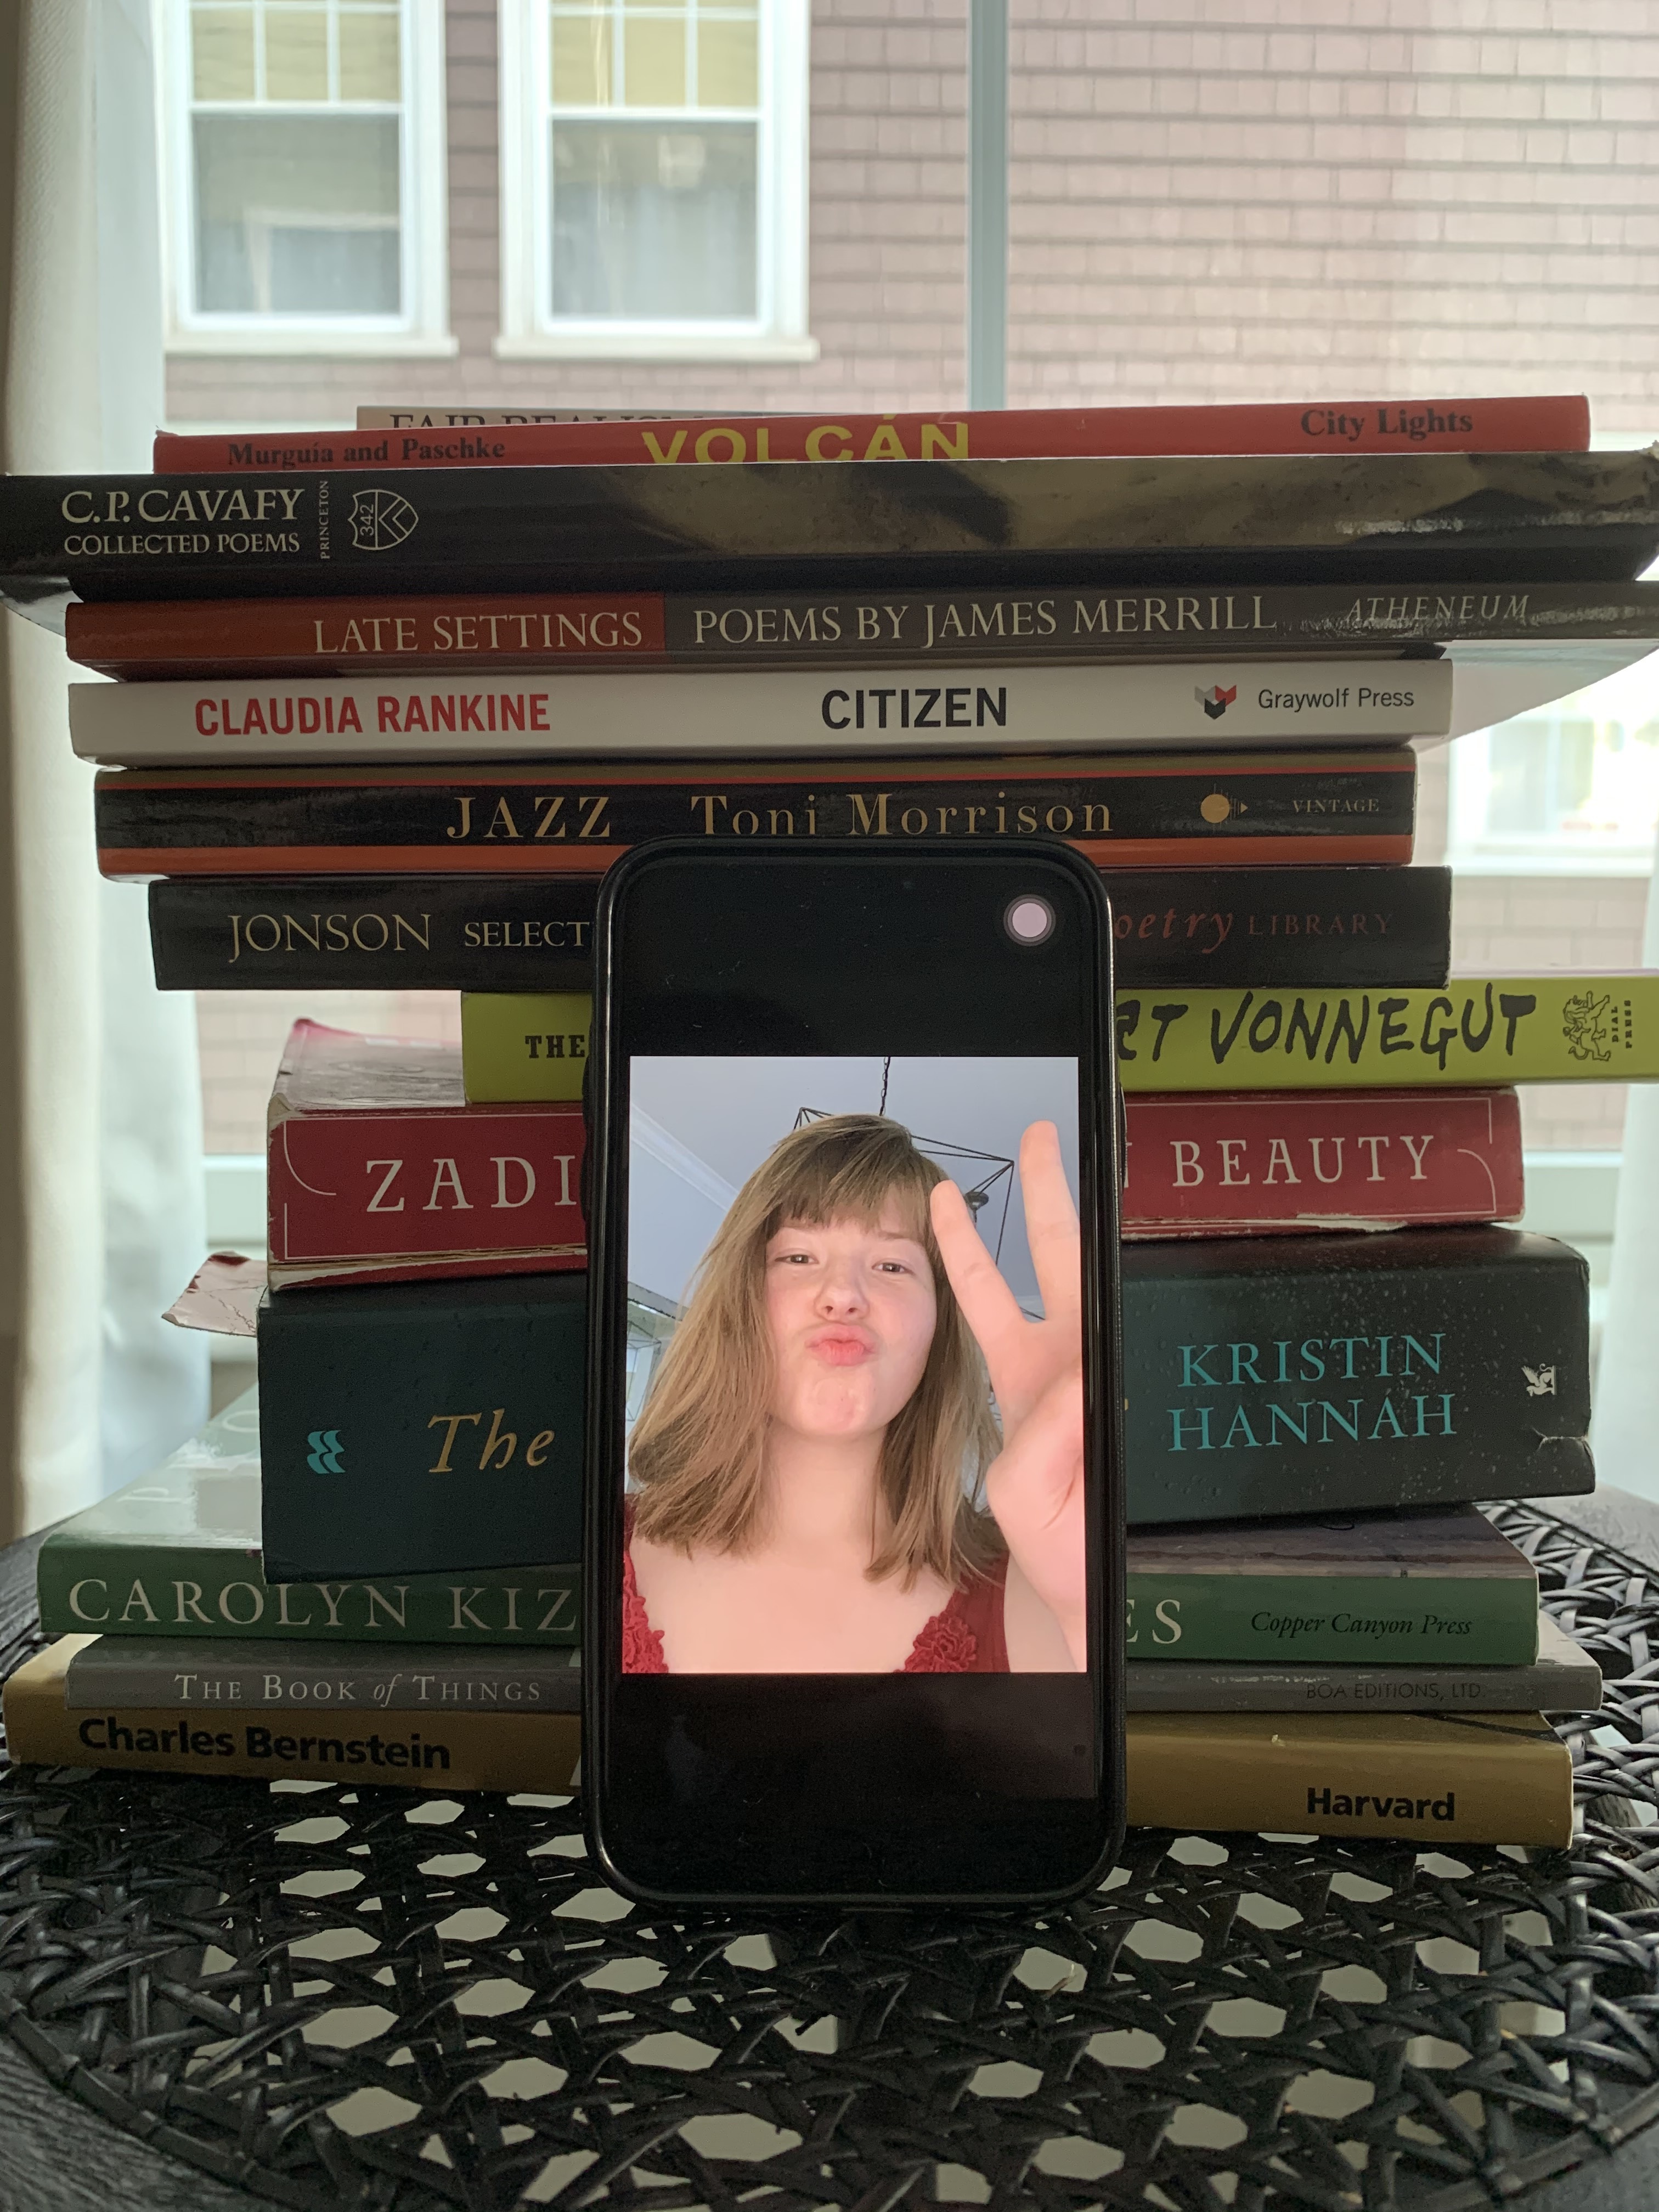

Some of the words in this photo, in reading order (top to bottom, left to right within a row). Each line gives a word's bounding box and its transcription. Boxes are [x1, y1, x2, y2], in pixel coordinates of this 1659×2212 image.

[641, 414, 969, 464] VOLCÁN
[1300, 409, 1364, 441] City
[1377, 408, 1474, 439] Lights
[343, 439, 388, 462] and
[402, 437, 506, 460] Paschke
[319, 481, 330, 558] PRINCETON
[359, 503, 375, 537] 342
[64, 534, 210, 555] COLLECTED
[218, 533, 300, 553] POEMS
[695, 607, 840, 643] POEMS
[857, 606, 908, 639] BY
[923, 601, 1056, 648] JAMES
[1073, 596, 1277, 633] MERRILL
[1346, 595, 1530, 622] ATHENEUM
[314, 618, 417, 652] LATE
[434, 612, 641, 650] SETTINGS
[196, 697, 362, 735] CLAUDIA
[378, 695, 550, 732] RANKINE
[822, 687, 1006, 729] CITIZEN
[1259, 688, 1349, 712] Graywolf
[1359, 688, 1414, 707] Press
[447, 797, 610, 838] JAZZ
[692, 795, 815, 834] Toni
[847, 792, 1112, 834] Morrison
[1294, 799, 1379, 812] VINTAGE
[228, 914, 430, 963] JONSON
[1249, 913, 1393, 935] LIBRARY
[526, 1035, 585, 1058] THE
[1211, 983, 1536, 1070] VONNEGUT
[1170, 1136, 1433, 1186] BEAUTY
[1177, 1334, 1446, 1387] KRISTIN
[428, 1409, 554, 1472] The
[1167, 1393, 1457, 1451] HANNAH
[69, 1579, 408, 1627] CAROLYN
[1251, 1612, 1325, 1638] Copper
[1331, 1614, 1412, 1639] Canyon
[1421, 1615, 1472, 1634] Press
[374, 1674, 402, 1707] of
[1306, 1683, 1346, 1699] BOA
[1355, 1683, 1446, 1702] EDITIONS,
[1452, 1683, 1486, 1699] LTD.
[79, 1717, 234, 1756] Charles
[246, 1724, 449, 1769] Bernstein
[1308, 1788, 1454, 1821] Harvard
